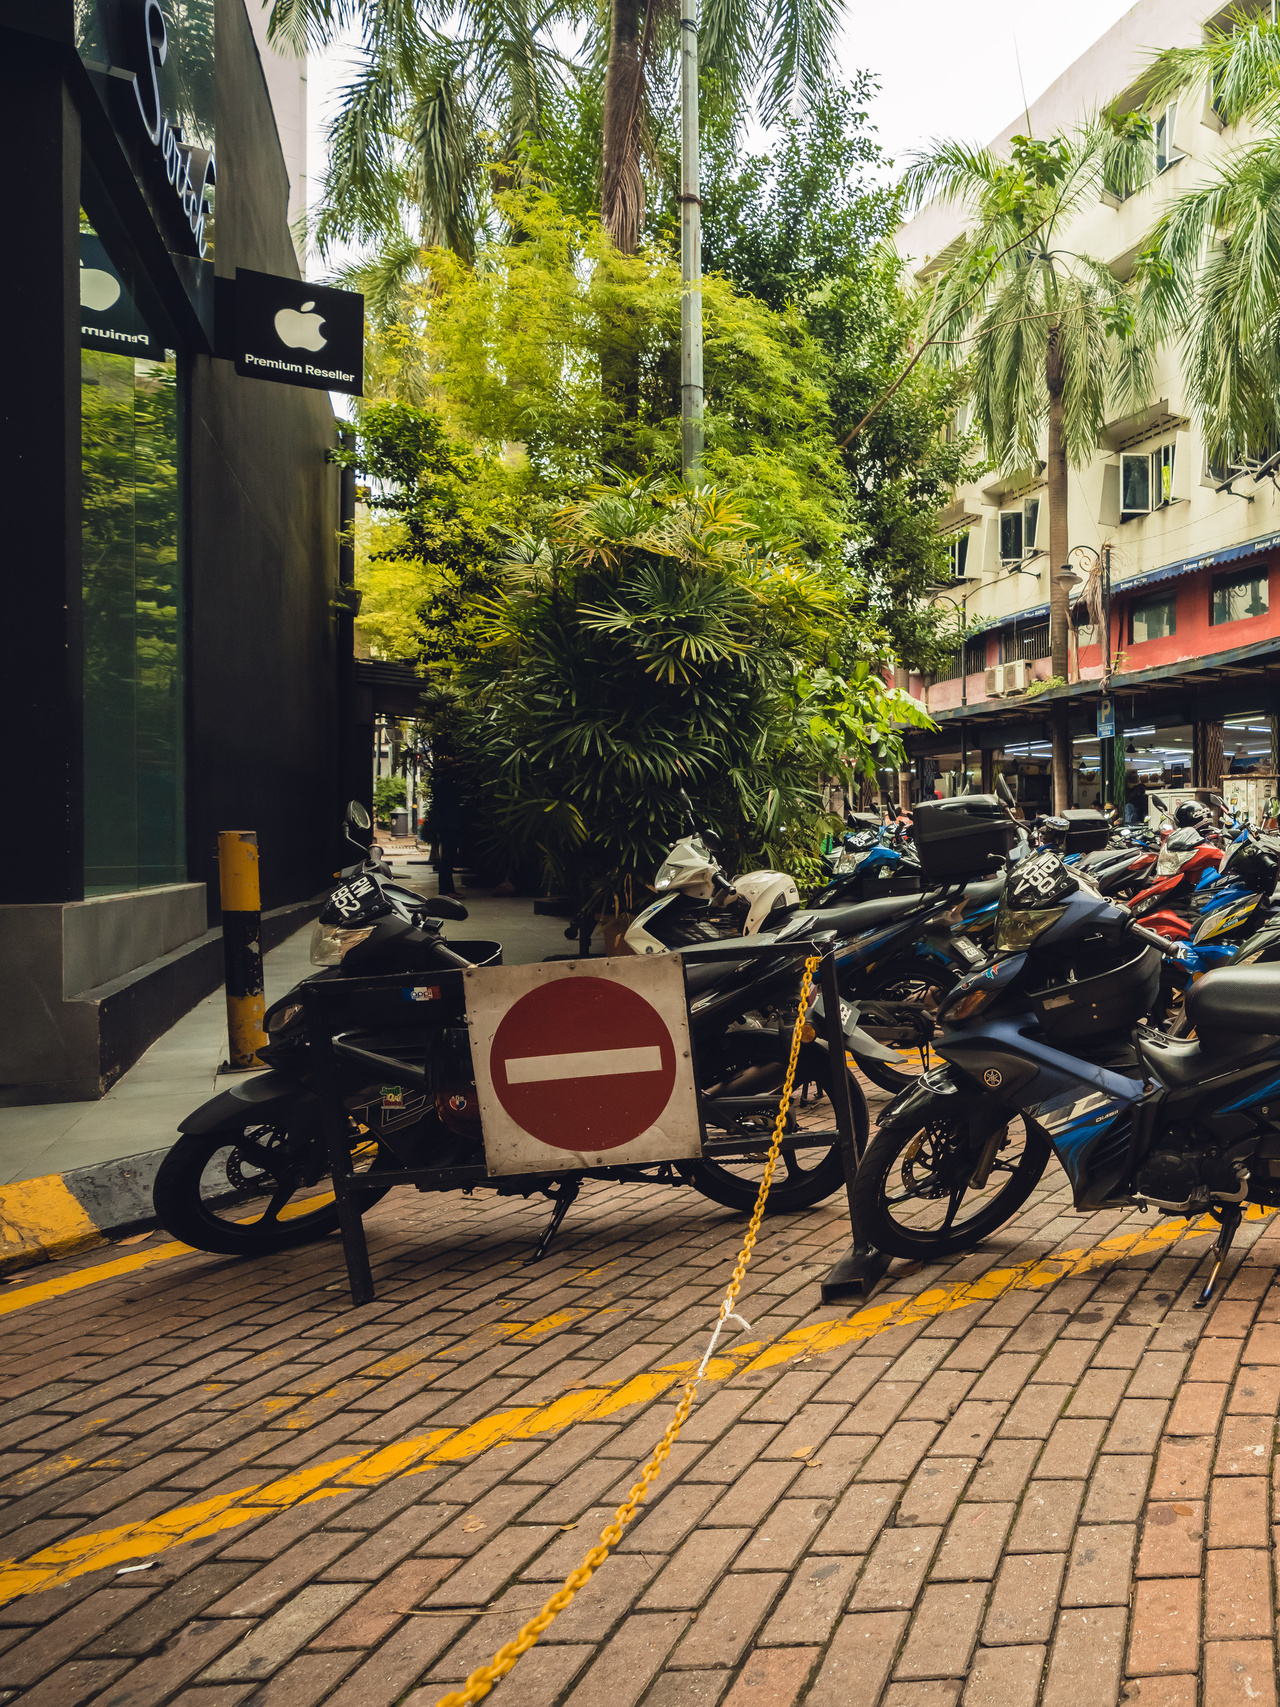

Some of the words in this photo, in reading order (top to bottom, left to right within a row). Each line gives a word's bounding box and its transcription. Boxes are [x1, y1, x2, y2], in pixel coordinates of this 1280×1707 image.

[245, 353, 303, 374] Premium
[305, 365, 355, 382] Reseller
[1101, 699, 1112, 723] P
[1013, 878, 1031, 896] V
